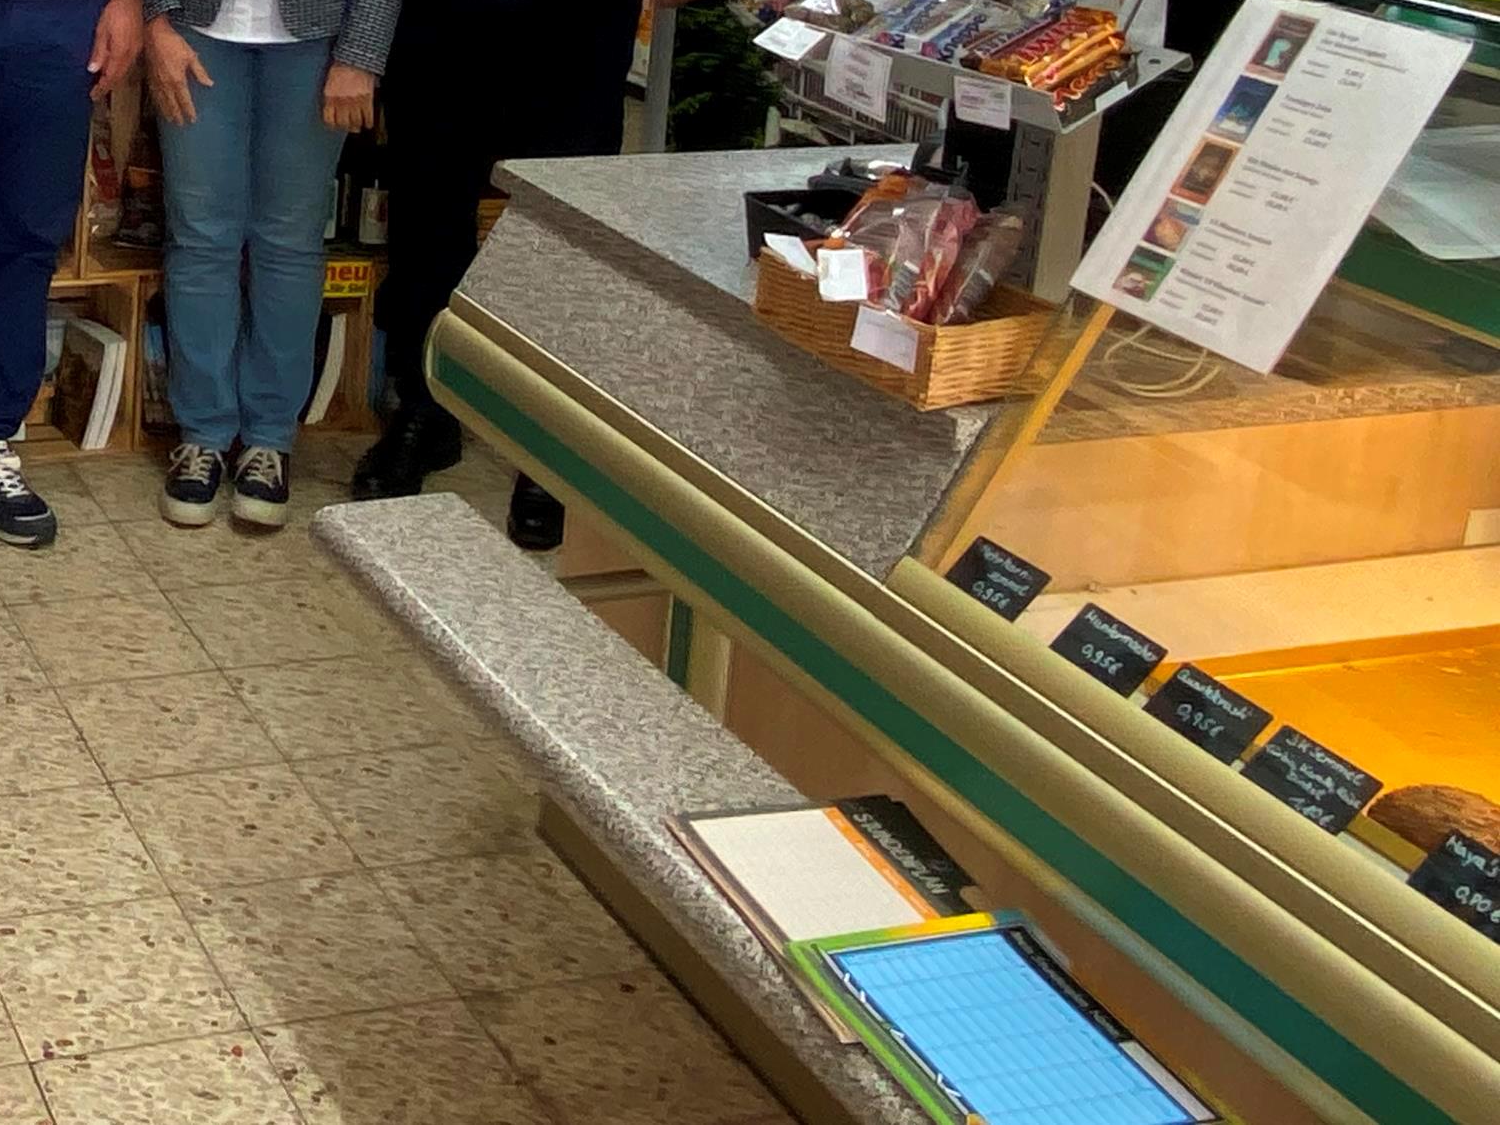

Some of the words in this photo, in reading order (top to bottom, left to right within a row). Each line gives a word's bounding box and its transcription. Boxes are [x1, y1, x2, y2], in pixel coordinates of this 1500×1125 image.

[972, 580, 1012, 610] 0,95€
[1080, 643, 1125, 677] 0,95€
[1175, 703, 1225, 738] 0,95€
